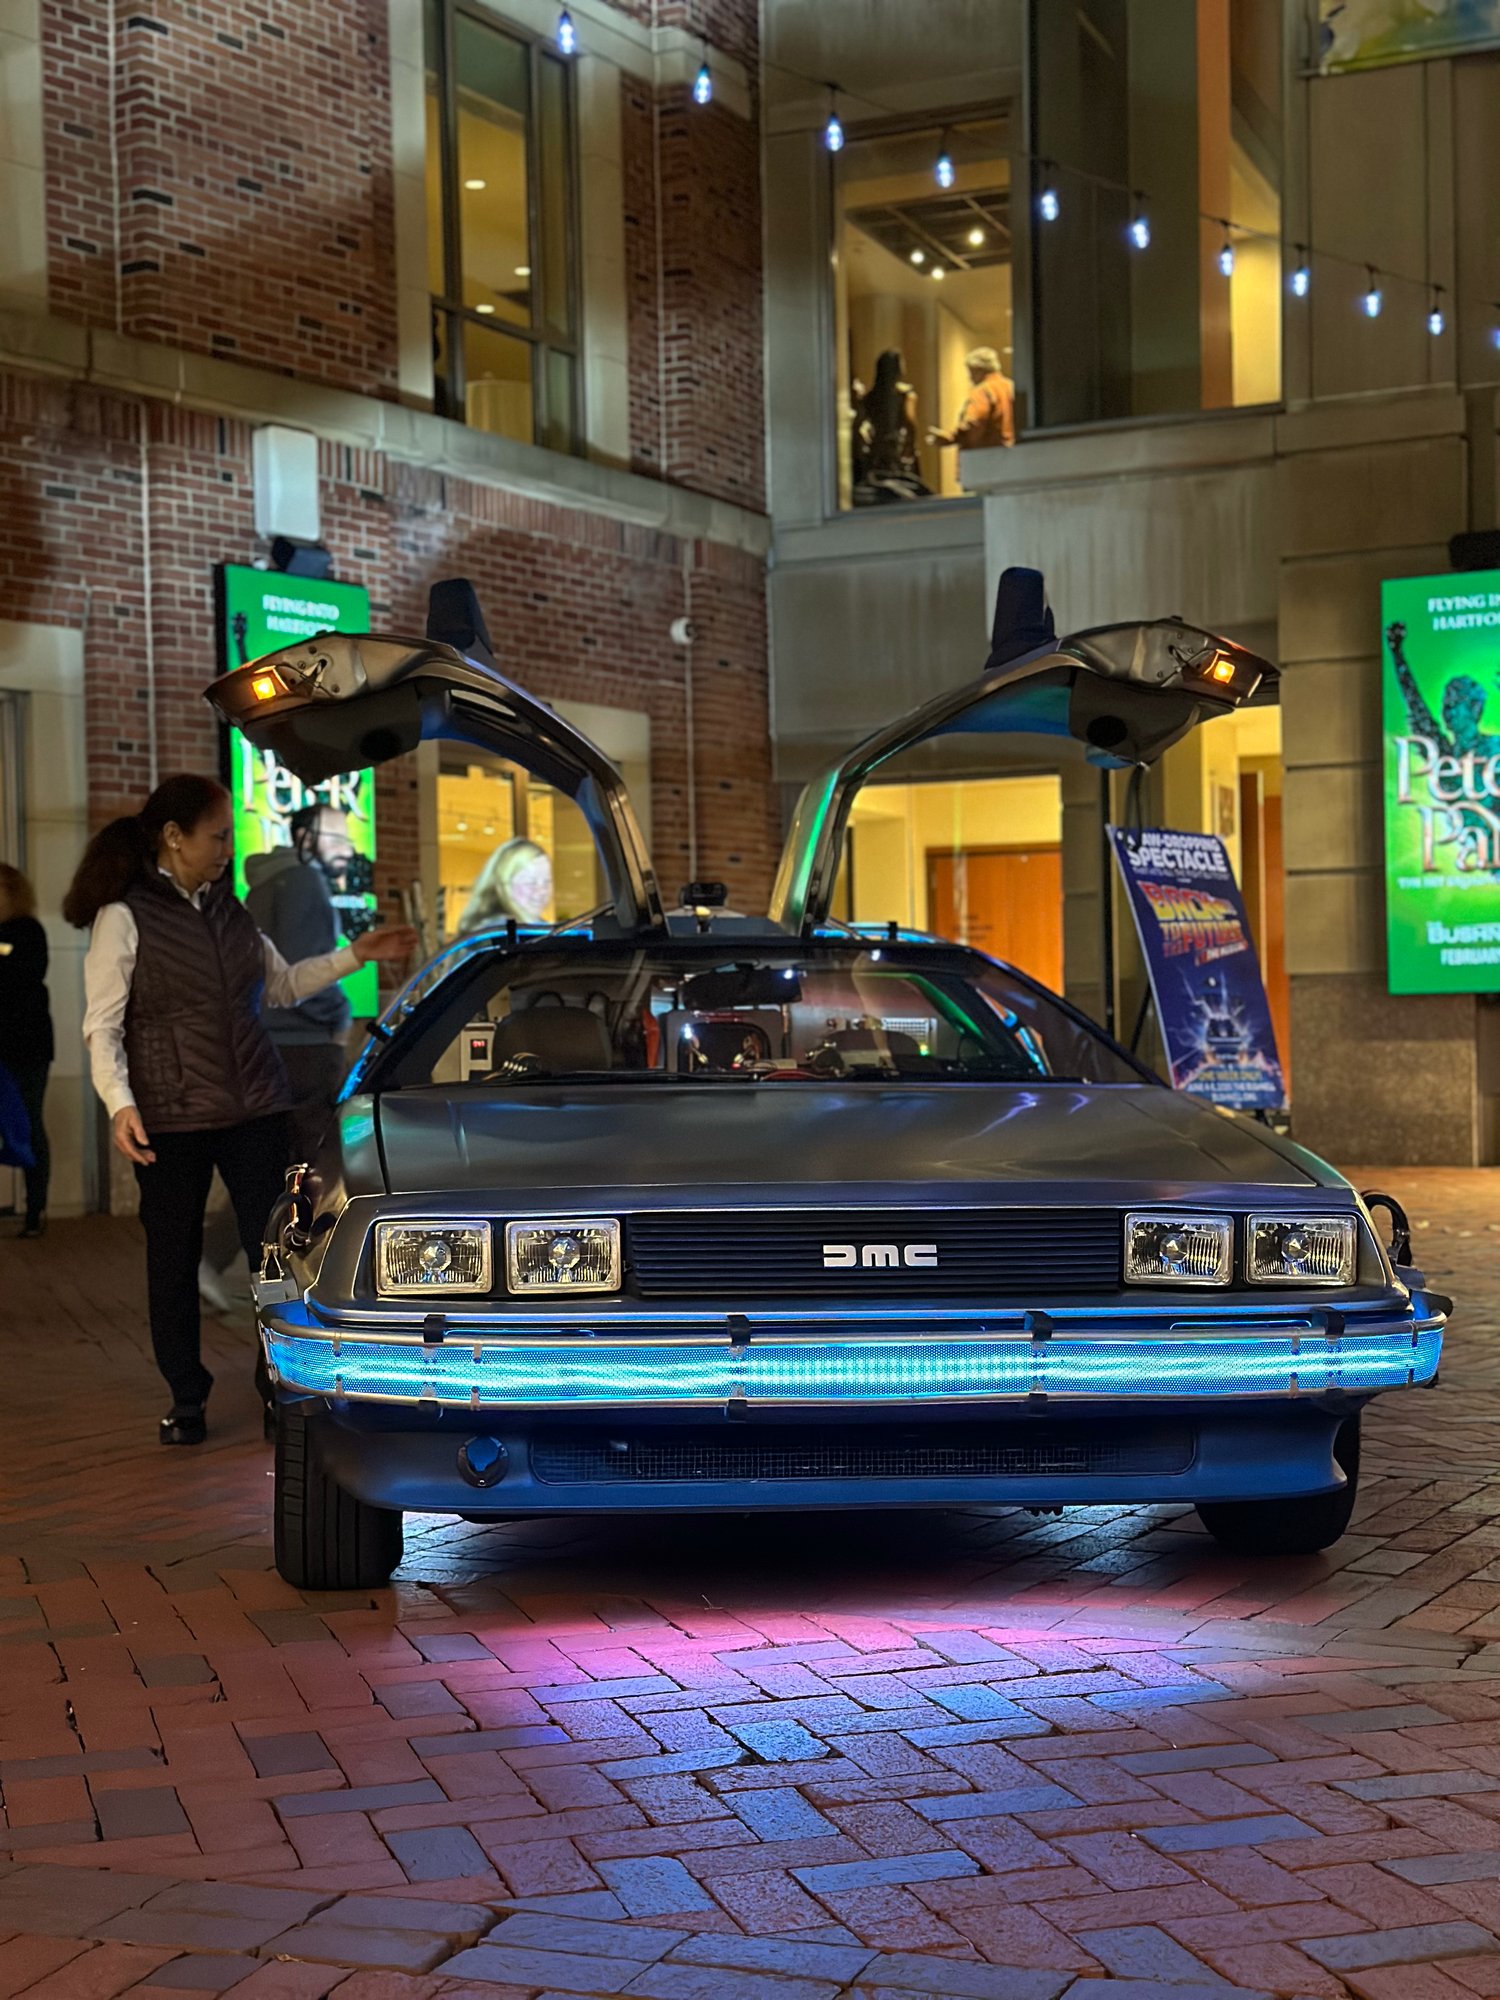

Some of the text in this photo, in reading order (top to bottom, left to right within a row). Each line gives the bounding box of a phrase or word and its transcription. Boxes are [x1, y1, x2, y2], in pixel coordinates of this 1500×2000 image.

[1427, 594, 1486, 613] FLYING
[1432, 612, 1500, 632] HARTFO
[1127, 832, 1221, 852] AW-DROPPING
[1126, 846, 1228, 872] SPECTACLE
[1136, 880, 1237, 920] BACK
[1180, 920, 1245, 953] FUTURE
[823, 1244, 938, 1268] DMC
